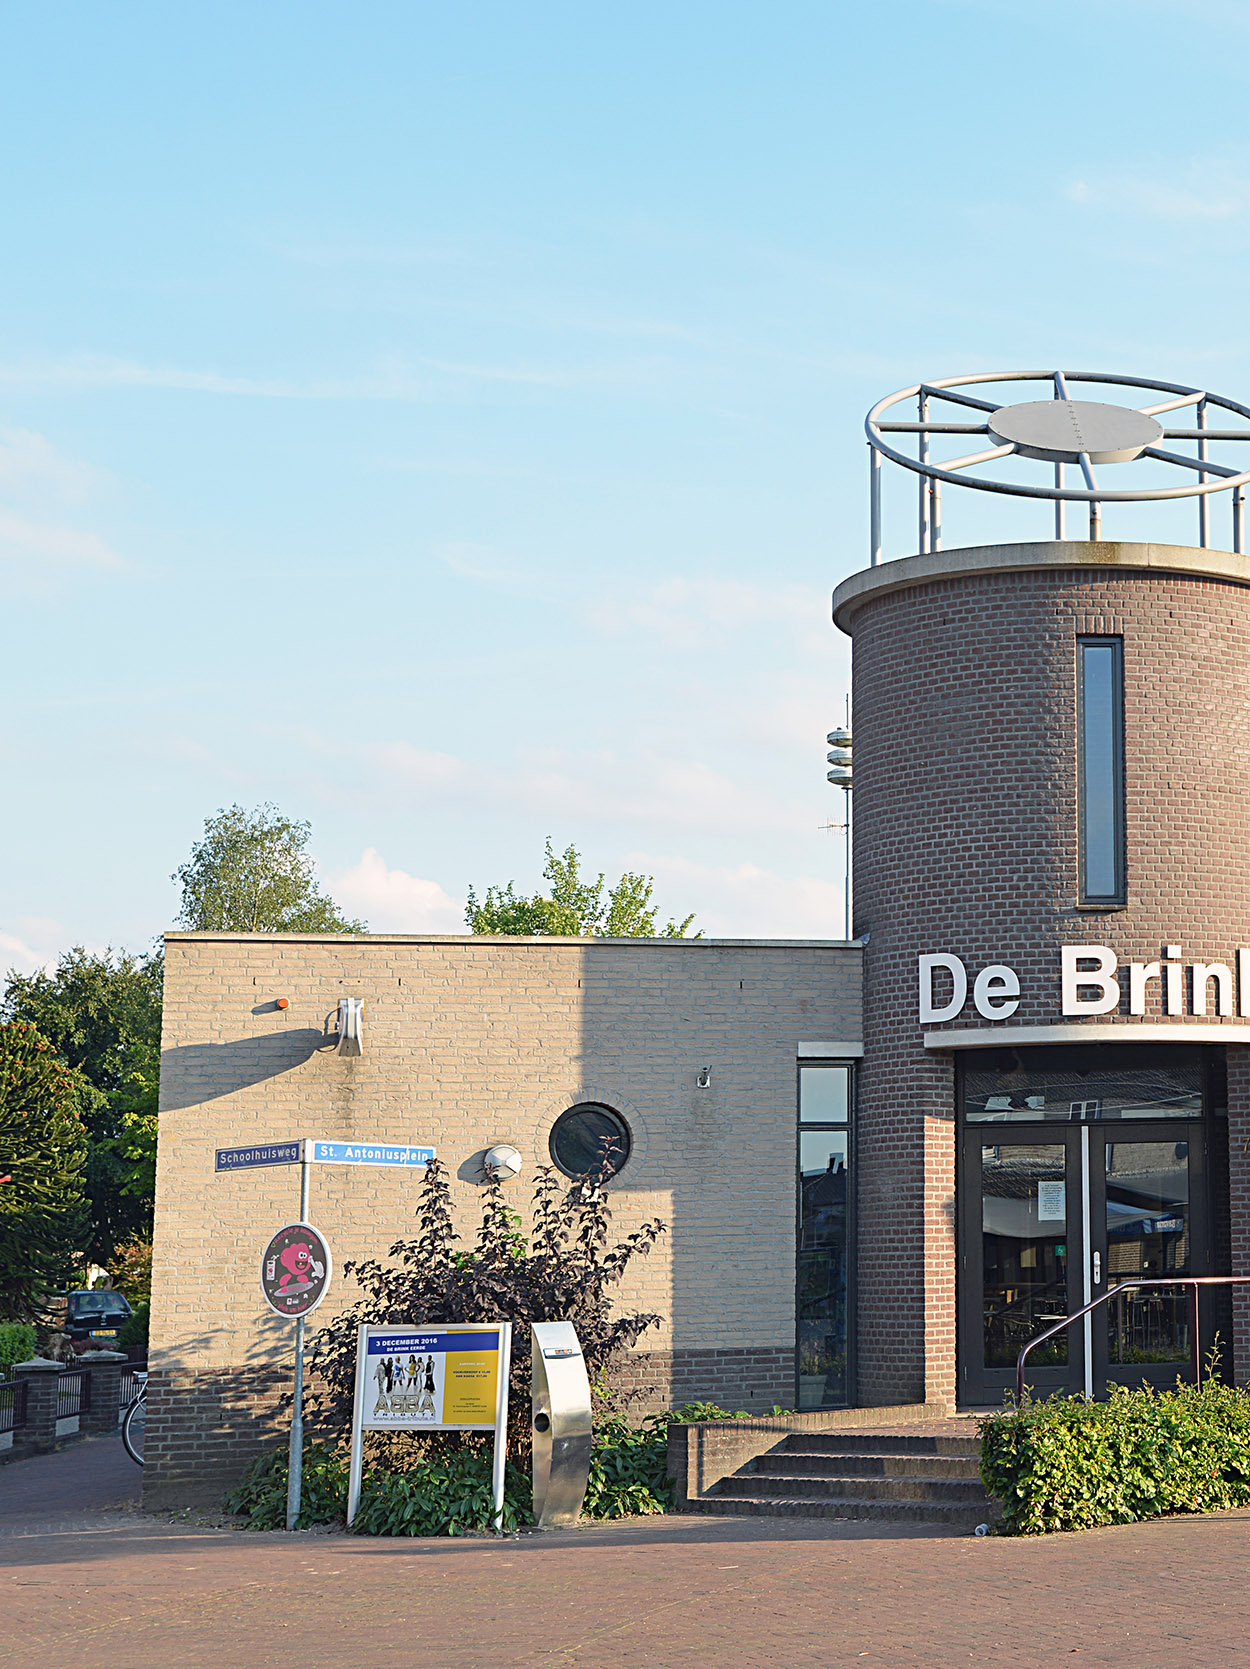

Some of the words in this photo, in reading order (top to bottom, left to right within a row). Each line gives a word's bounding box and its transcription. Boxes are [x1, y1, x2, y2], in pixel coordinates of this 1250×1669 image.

[919, 952, 1020, 1024] De
[320, 1145, 337, 1157] St.
[345, 1146, 429, 1163] Antoniusplein
[1242, 1137, 1250, 1153] 7
[219, 1146, 297, 1164] Schoolhuisweg
[382, 1339, 420, 1347] DECEMBER
[373, 1394, 436, 1413] ABBA
